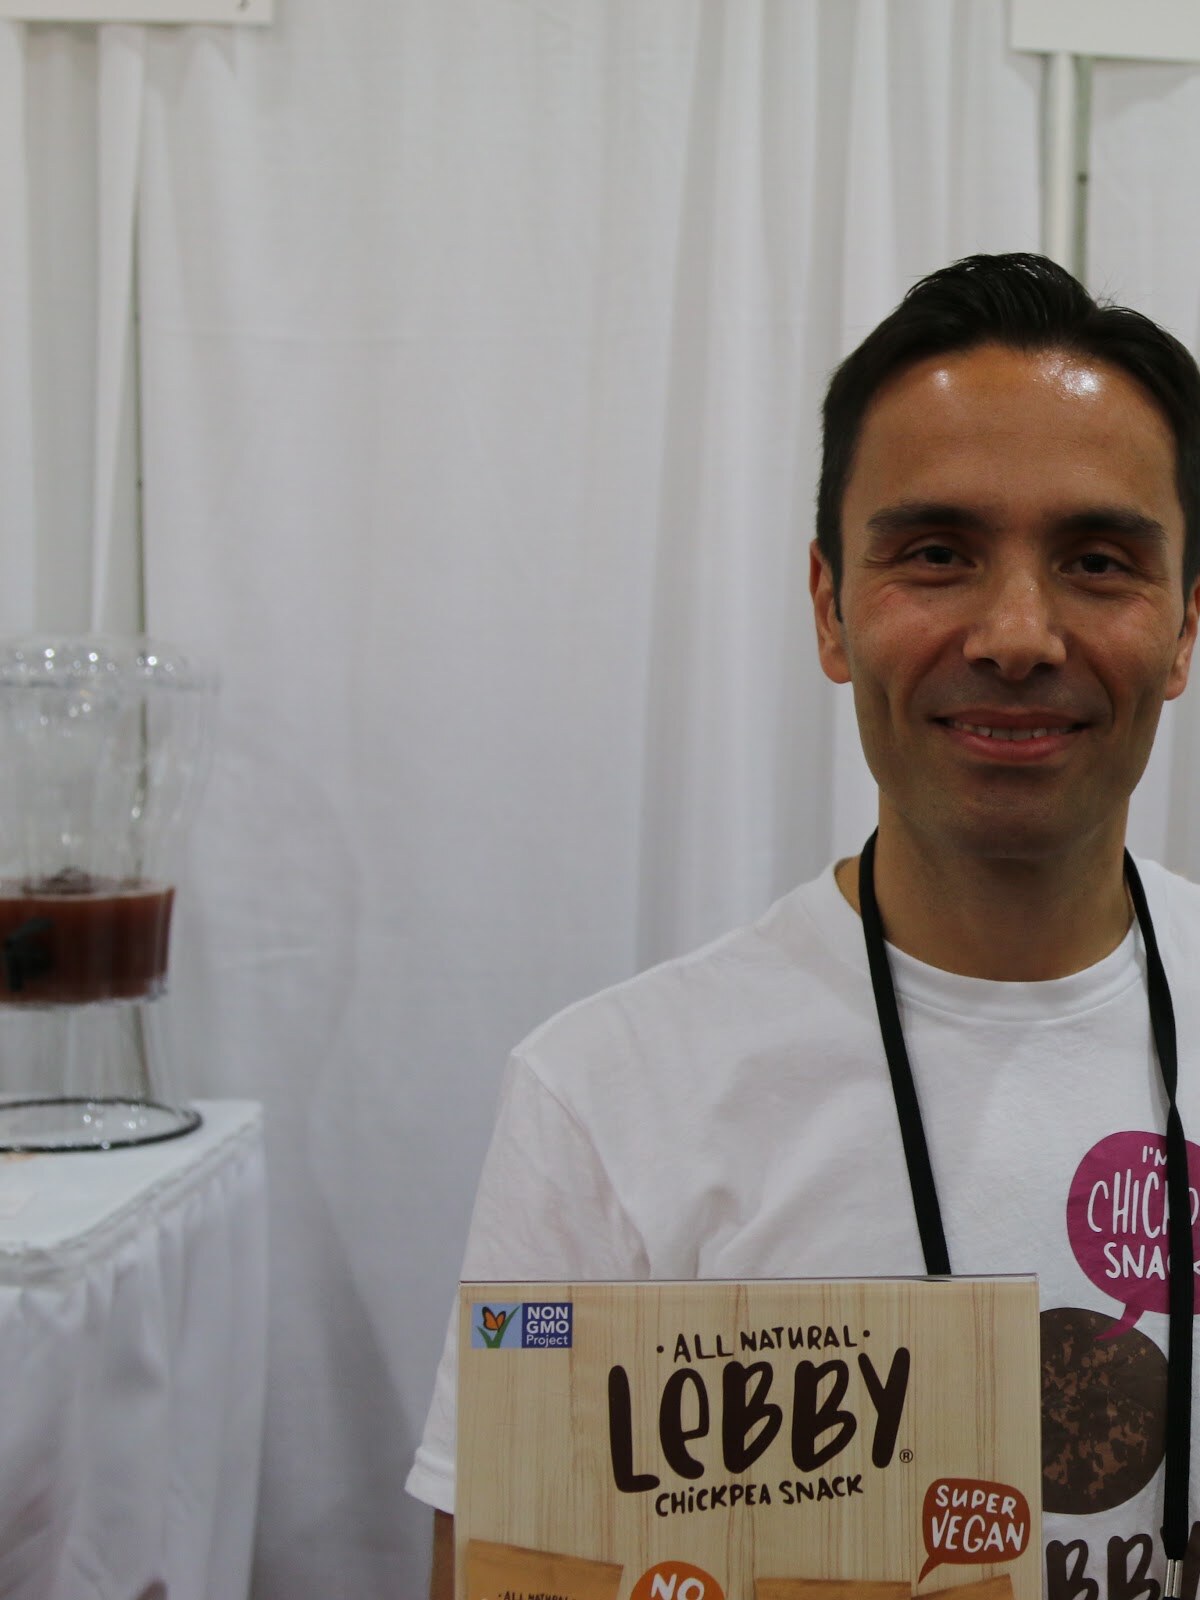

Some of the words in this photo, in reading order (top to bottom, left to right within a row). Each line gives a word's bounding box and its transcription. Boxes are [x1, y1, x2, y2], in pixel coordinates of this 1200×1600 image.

[526, 1320, 570, 1334] GMO
[527, 1306, 569, 1320] NON
[526, 1334, 568, 1348] Project
[674, 1334, 734, 1363] ALL
[740, 1325, 858, 1352] NATURAL
[778, 1474, 864, 1505] SNACK
[935, 1485, 1017, 1519] SUPER
[931, 1508, 1025, 1553] VEGAN
[650, 1573, 705, 1600] NO
